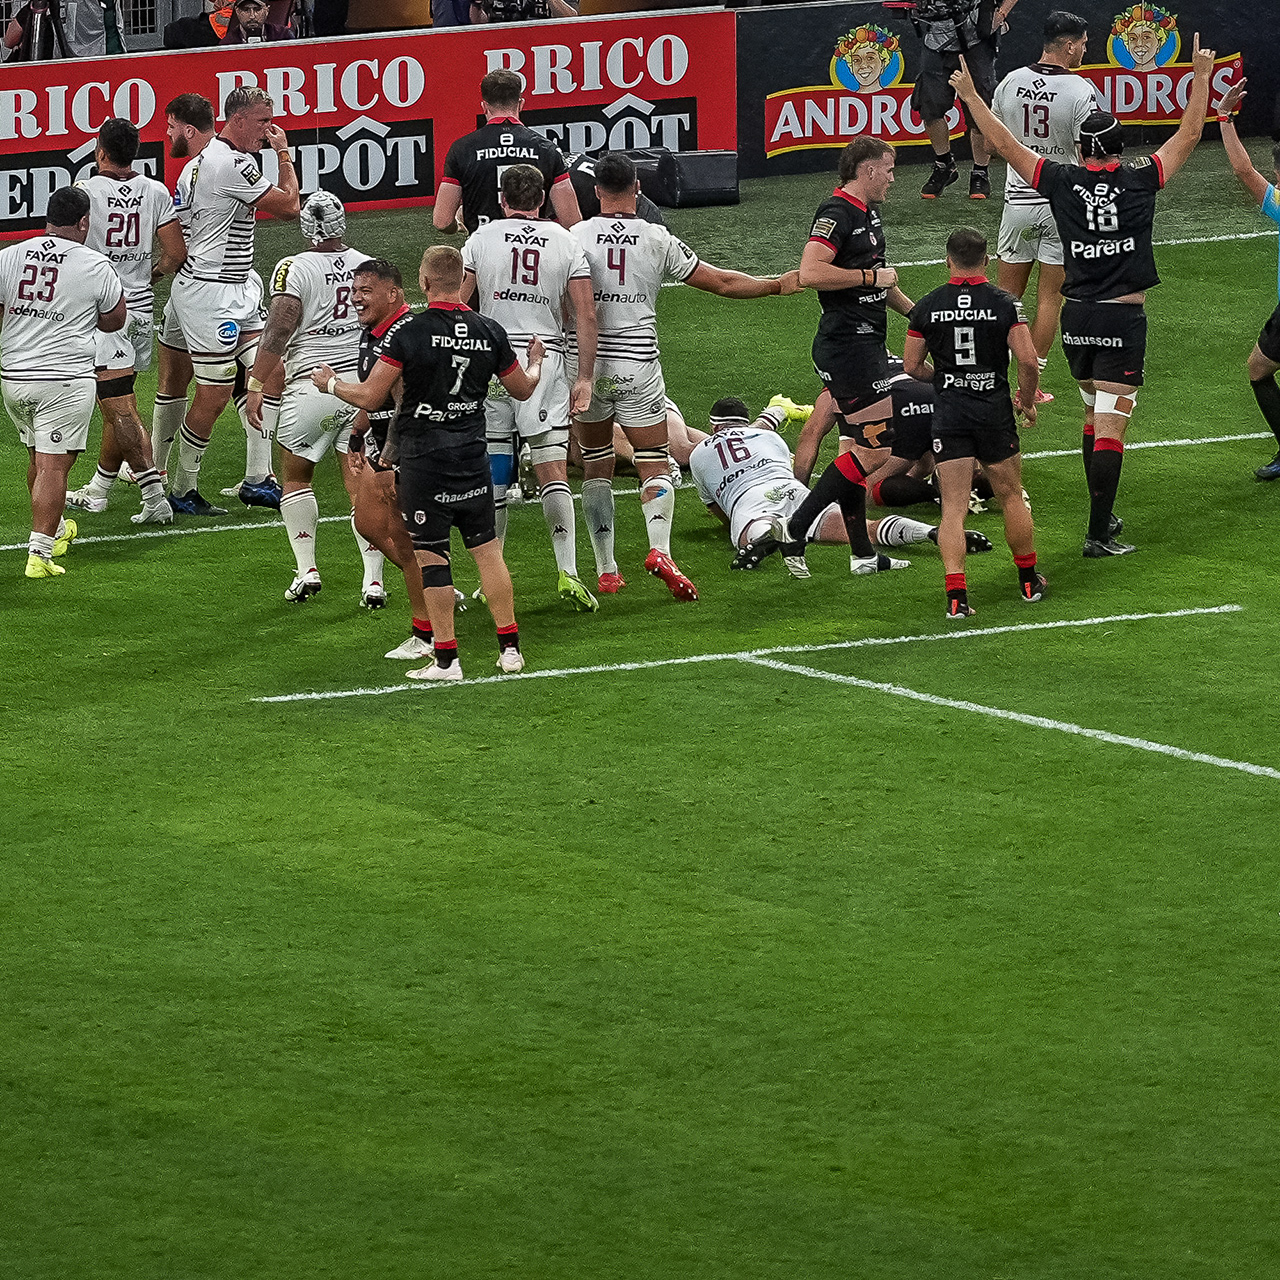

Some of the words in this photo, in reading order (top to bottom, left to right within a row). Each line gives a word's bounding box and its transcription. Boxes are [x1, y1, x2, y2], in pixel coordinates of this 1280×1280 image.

[483, 33, 690, 96] BRICO
[1015, 86, 1058, 103] FAYAT
[1021, 103, 1051, 139] 13
[475, 146, 539, 161] FIDUCIAL
[107, 195, 145, 209] FAYAT
[1071, 183, 1127, 208] FIDUCAL
[104, 211, 141, 248] 20
[504, 232, 549, 248] FAYAT
[596, 233, 640, 246] FAYAT
[1070, 236, 1136, 260] Parera
[24, 250, 68, 265] FAYAT
[104, 250, 154, 263] denauto
[510, 246, 541, 287] 19
[606, 247, 627, 286] 4
[17, 263, 59, 303] 23
[325, 271, 354, 286] FAYA
[333, 286, 351, 320] 8
[593, 289, 647, 304] denauto
[8, 304, 65, 322] edenauto
[929, 309, 998, 323] FIDUCIAL
[431, 334, 492, 352] FIDUCIAL
[952, 326, 977, 367] 9
[448, 354, 471, 396] 7
[941, 373, 996, 392] Parera
[965, 371, 996, 381] GROUPE
[713, 436, 751, 471] 16
[433, 485, 489, 504] chausson
